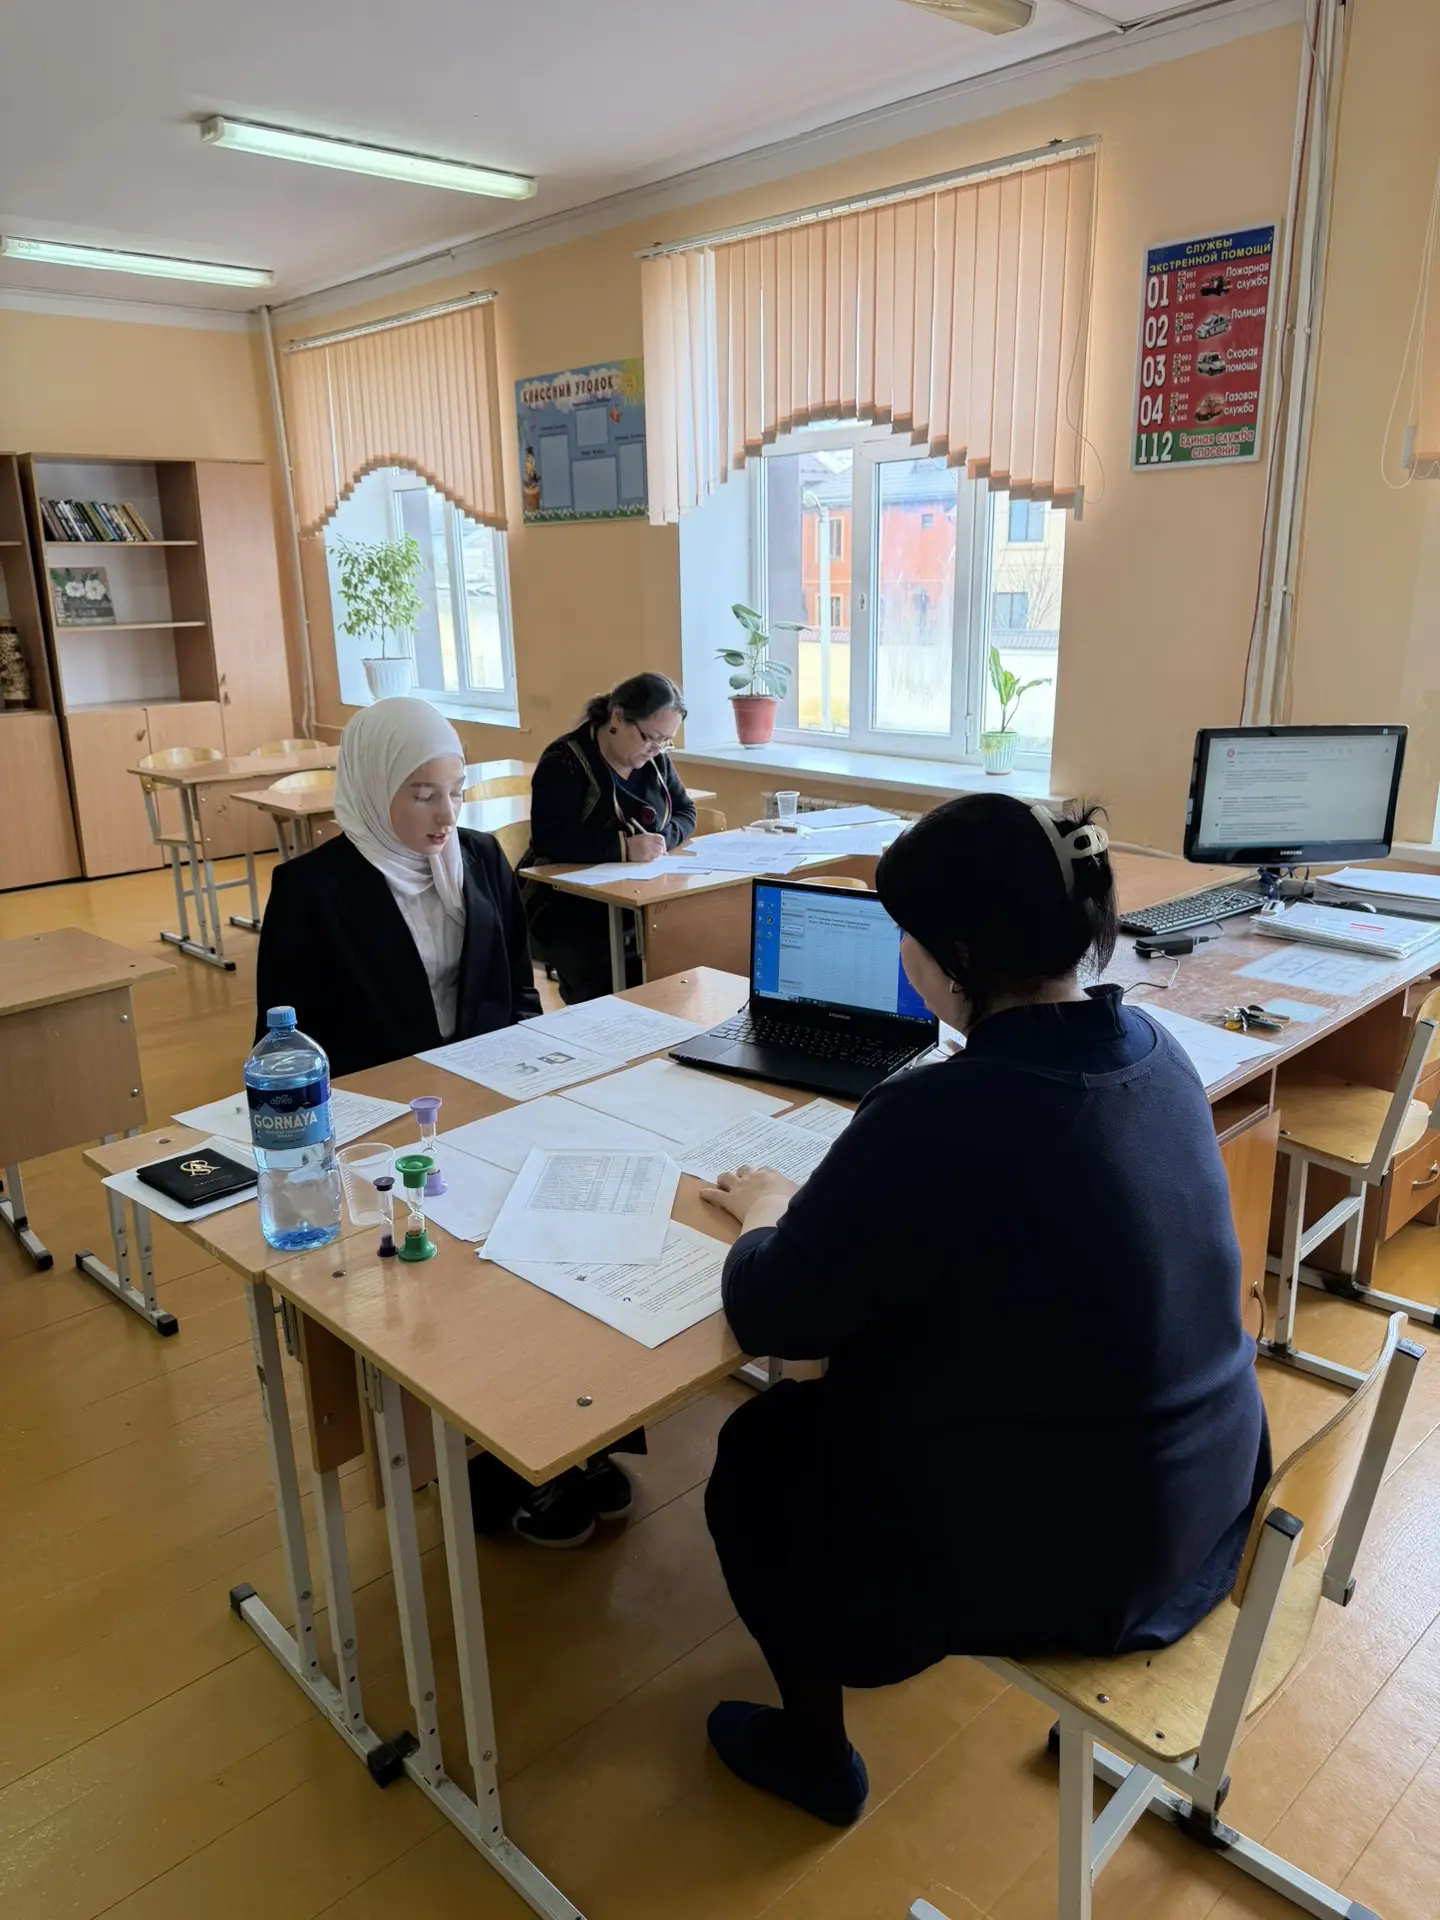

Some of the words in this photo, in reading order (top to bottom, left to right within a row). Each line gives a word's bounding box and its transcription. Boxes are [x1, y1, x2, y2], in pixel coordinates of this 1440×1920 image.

[1186, 238, 1232, 255] СЛУЖБЫ
[1149, 252, 1218, 273] ЭКСТРЕННОЙ
[1221, 243, 1271, 260] ПОМОЩИ
[1226, 262, 1269, 278] Пожарная
[1147, 274, 1169, 309] 01
[1236, 275, 1268, 290] служба
[1231, 307, 1265, 319] Полиция
[1145, 314, 1168, 349] 02
[1226, 347, 1258, 360] Скорая
[1143, 354, 1166, 388] 03
[1225, 362, 1257, 373] помощь
[522, 380, 572, 404] КЛАССНЫЙ
[575, 375, 614, 395] УГОЛОК
[1225, 391, 1257, 402] Газовая
[1140, 393, 1163, 427] 04
[1223, 402, 1254, 416] служба
[1180, 433, 1214, 448] Единая
[1216, 426, 1254, 445] служба
[1138, 430, 1173, 463] 112
[1191, 444, 1240, 458] спасения
[254, 1110, 318, 1130] GORNAYA
